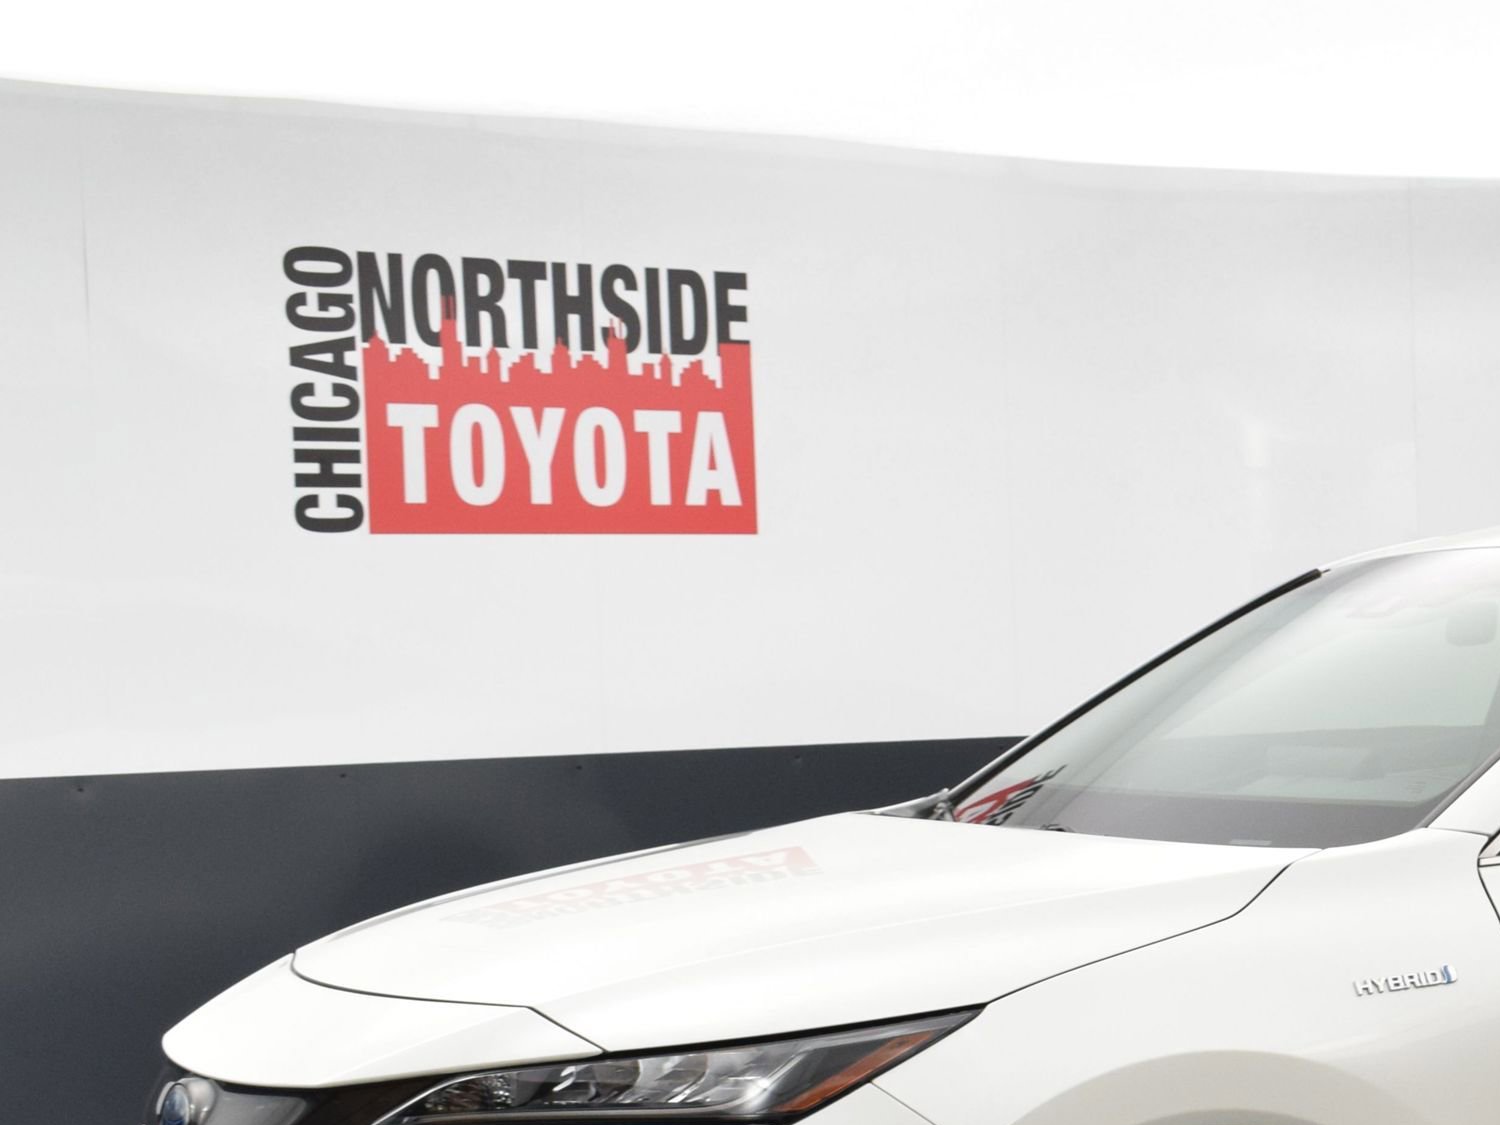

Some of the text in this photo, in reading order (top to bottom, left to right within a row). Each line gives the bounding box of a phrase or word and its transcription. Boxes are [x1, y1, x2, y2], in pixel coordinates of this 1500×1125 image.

[357, 251, 750, 356] NORTHSIDE
[282, 246, 364, 533] CHICAGO
[386, 403, 742, 507] TOYOTA
[1353, 969, 1441, 997] HYBRID
